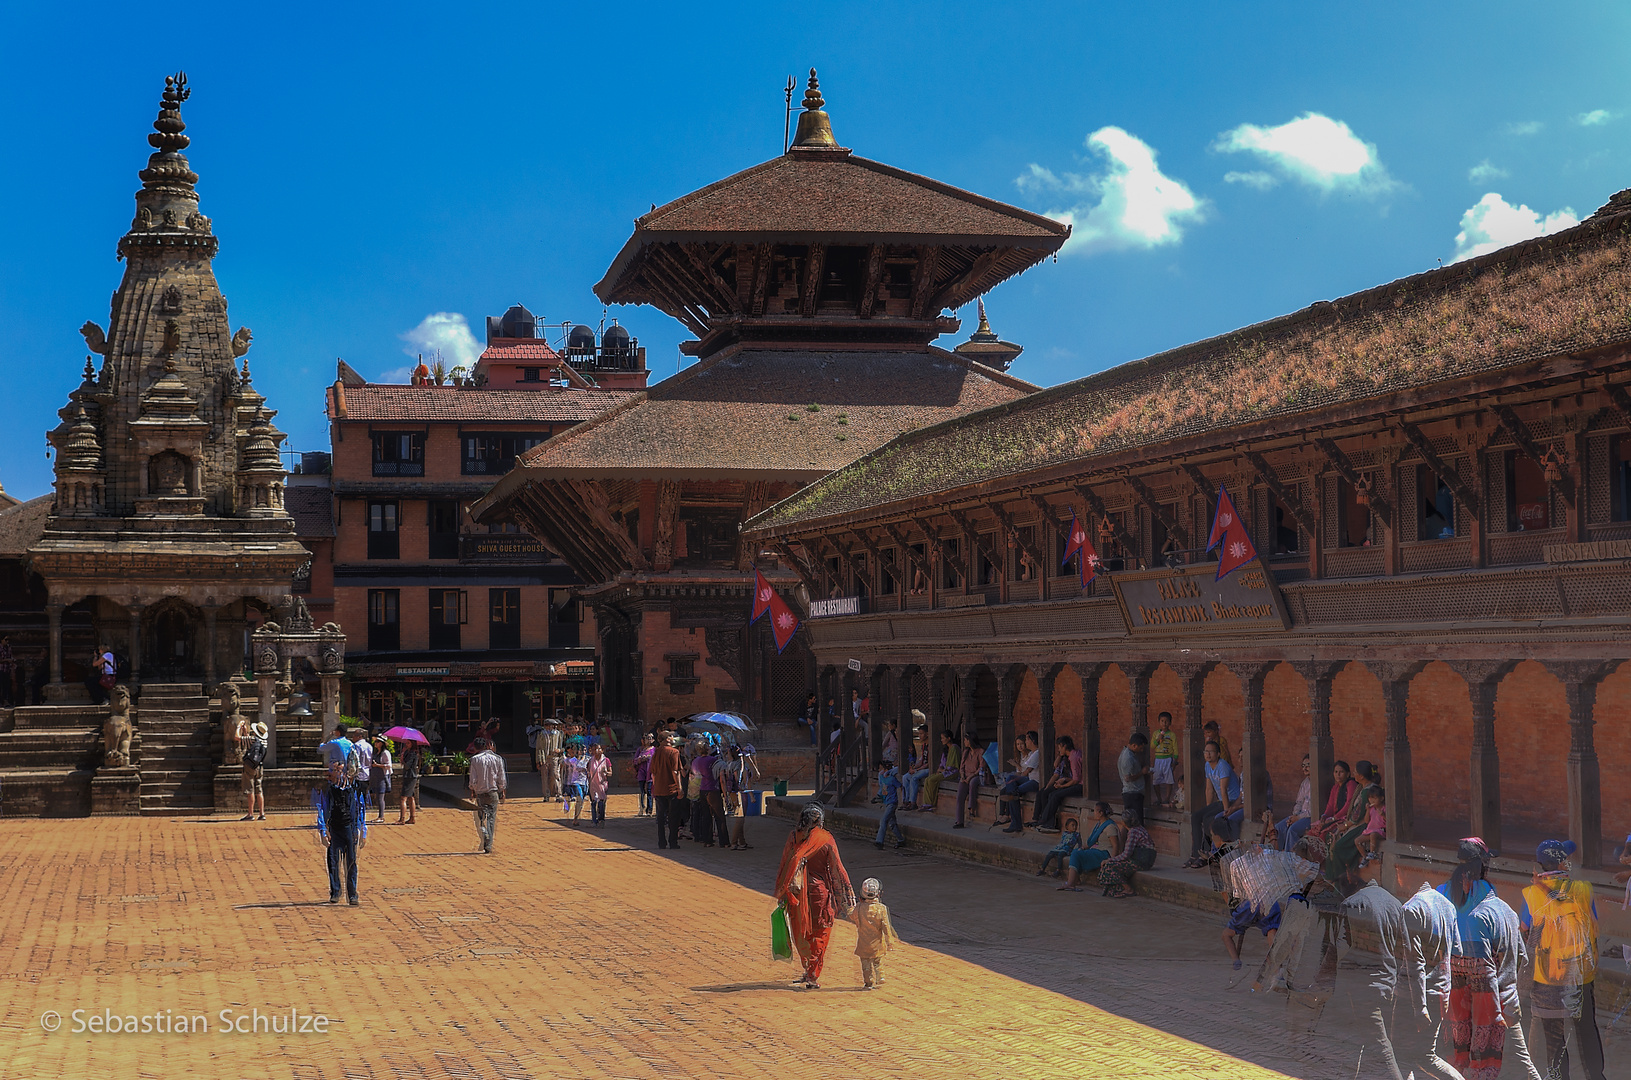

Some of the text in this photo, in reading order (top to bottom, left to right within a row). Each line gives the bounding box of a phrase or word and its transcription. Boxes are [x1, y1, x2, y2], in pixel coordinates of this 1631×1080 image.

[477, 544, 545, 553] SHIVA GUEST HOUSE
[810, 597, 857, 617] PALACE RESTAURANT
[1211, 601, 1273, 620] Bhaktapur
[849, 660, 860, 669] OPEN
